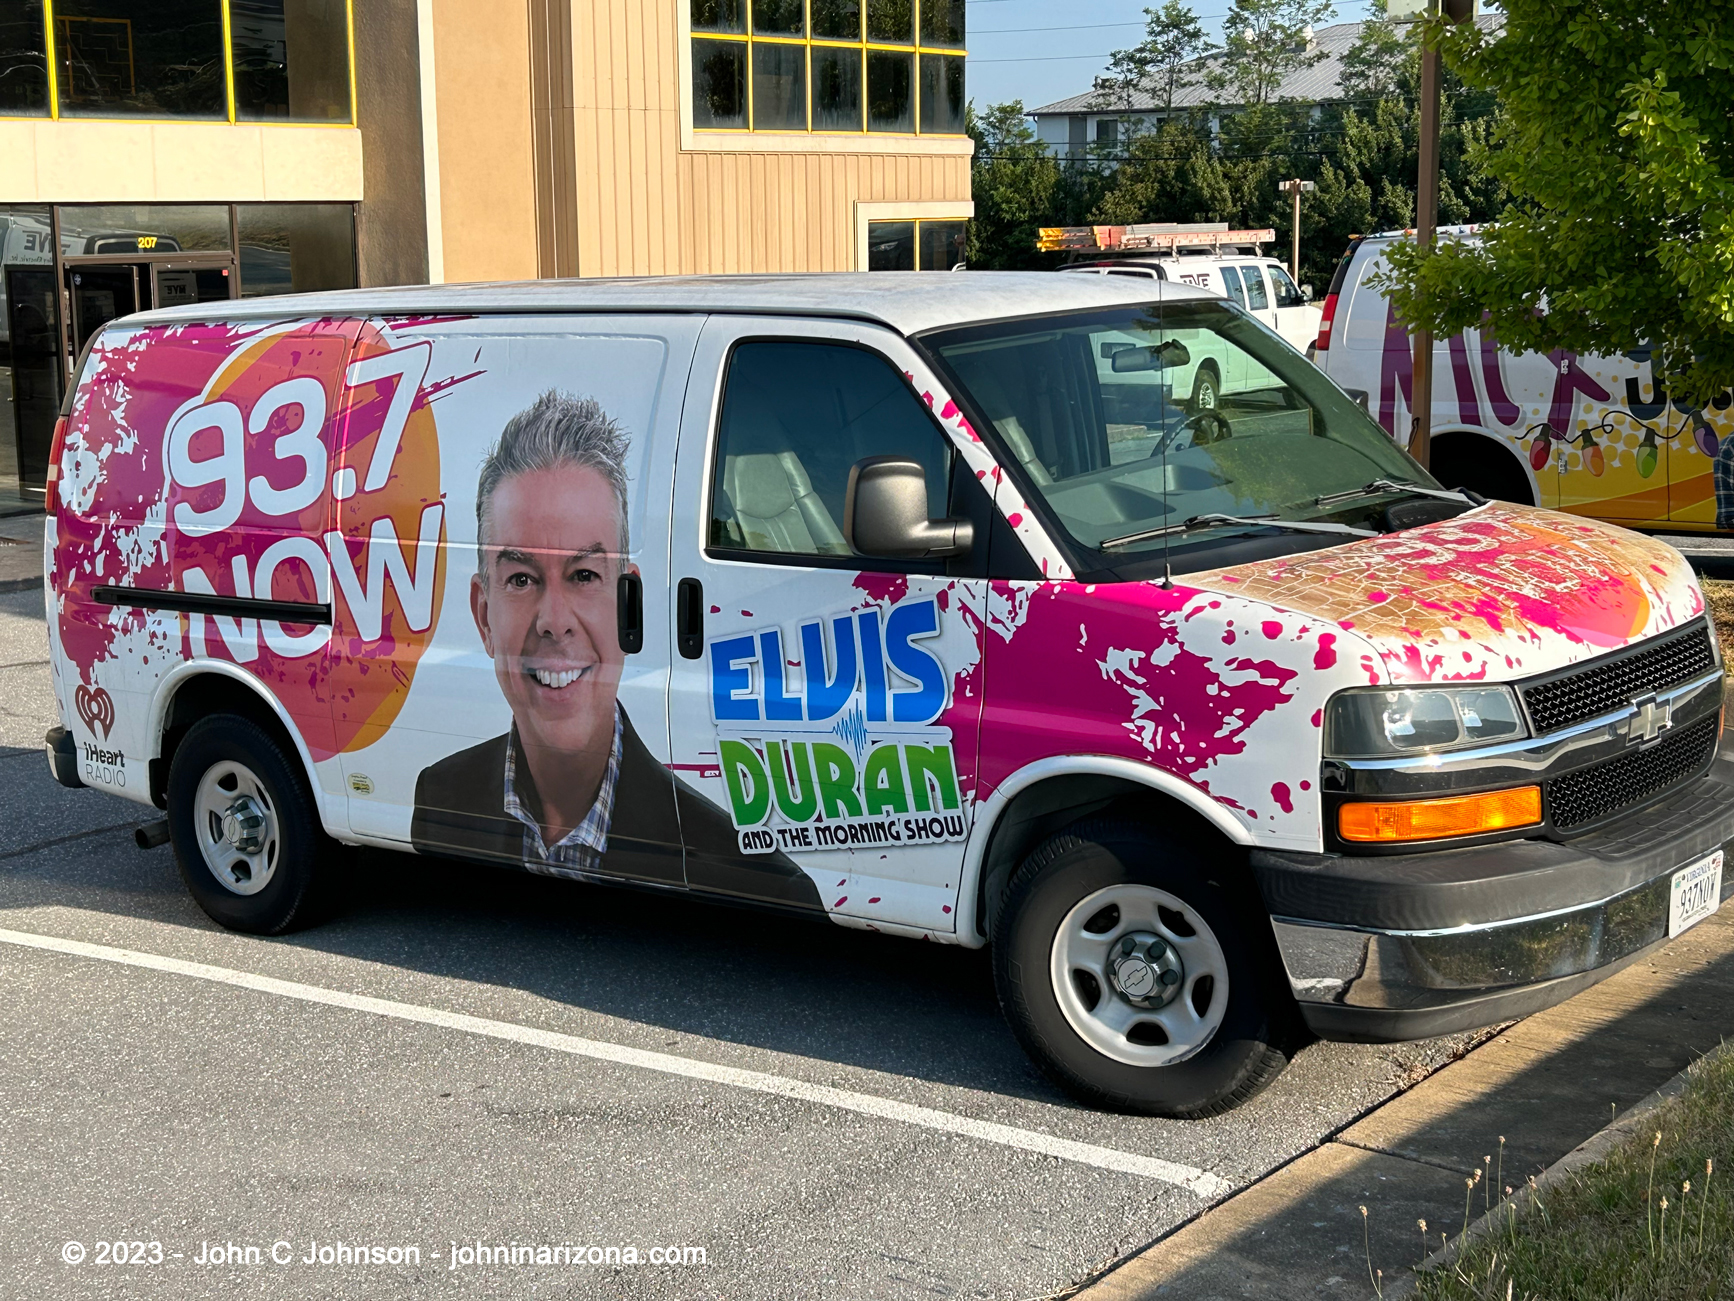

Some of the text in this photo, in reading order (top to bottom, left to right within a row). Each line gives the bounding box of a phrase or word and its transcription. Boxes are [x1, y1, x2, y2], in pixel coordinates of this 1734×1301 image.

[138, 237, 157, 248] 207
[168, 341, 432, 536] 93.7
[182, 501, 444, 663] NOW
[709, 599, 946, 723] ELVIS
[84, 741, 125, 768] iHeart
[85, 763, 126, 788] RADIO
[719, 739, 959, 827] DURAN
[742, 815, 964, 850] AND THE MORNING SHOW
